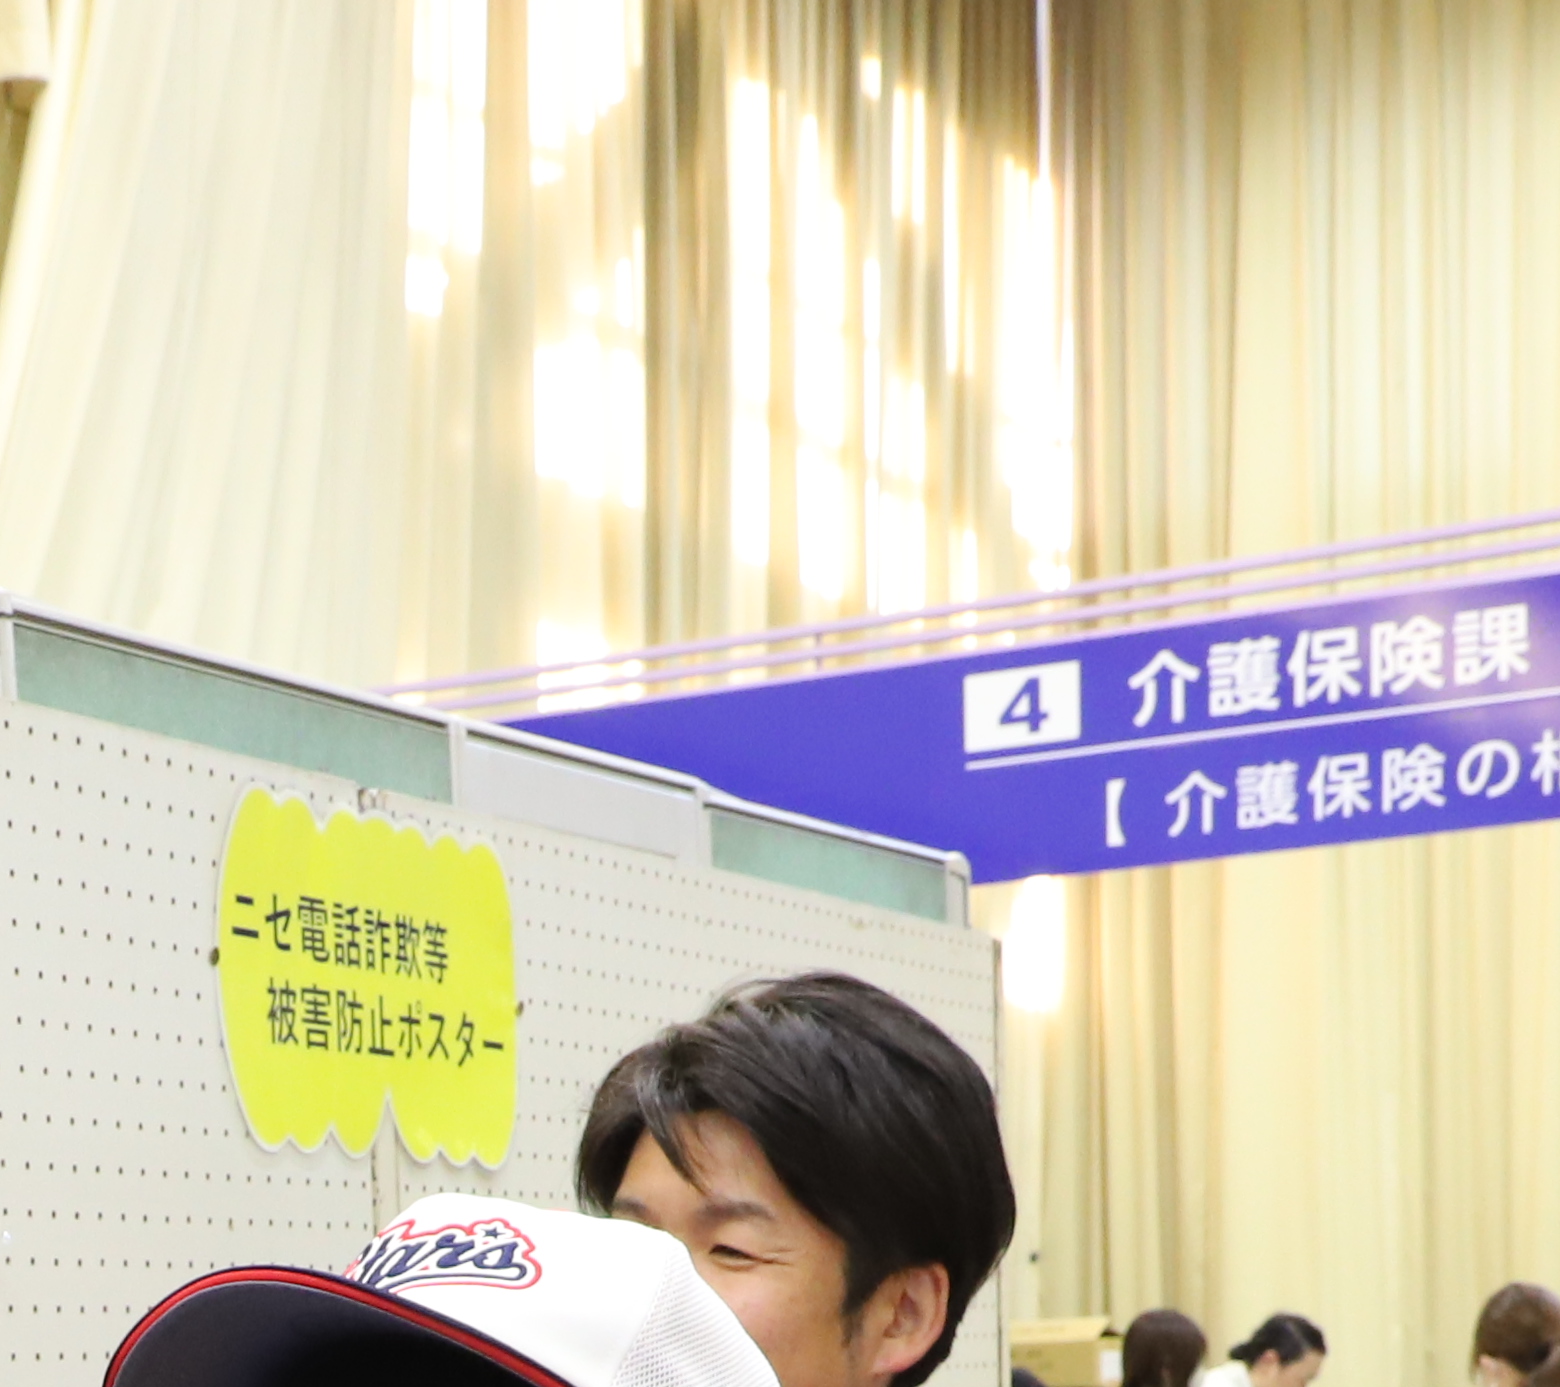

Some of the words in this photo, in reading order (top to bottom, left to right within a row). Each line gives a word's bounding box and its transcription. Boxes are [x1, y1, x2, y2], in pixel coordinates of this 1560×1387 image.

[996, 676, 1051, 737] 4
[1127, 604, 1531, 729] 介護保険課
[230, 891, 451, 985] ニセ電話詐欺等
[265, 975, 505, 1068] 被害防止ポスター
